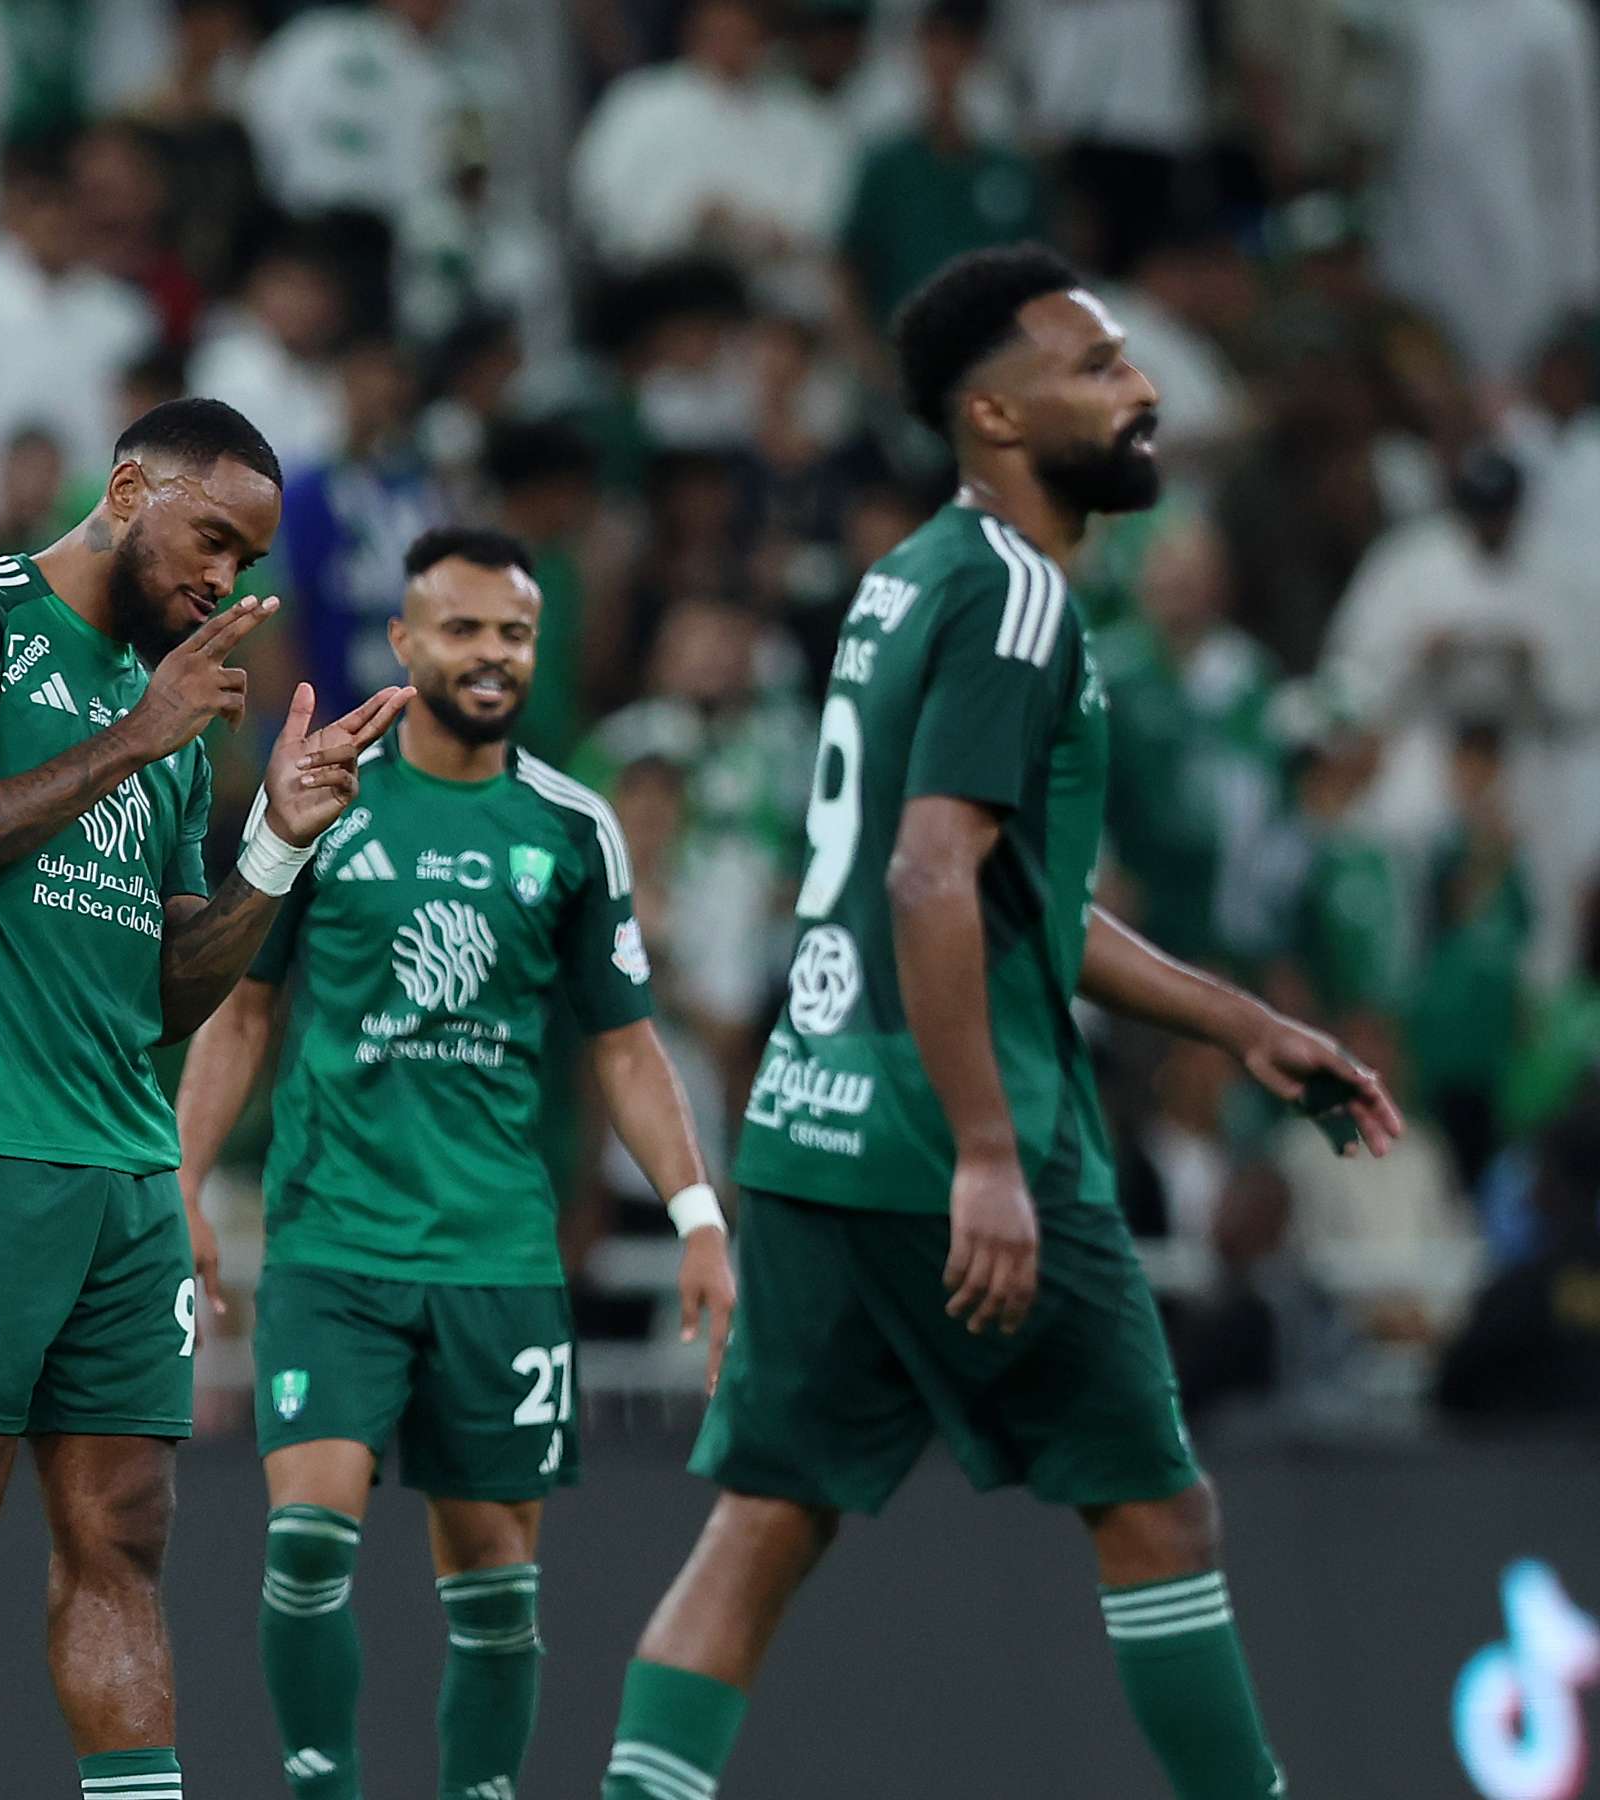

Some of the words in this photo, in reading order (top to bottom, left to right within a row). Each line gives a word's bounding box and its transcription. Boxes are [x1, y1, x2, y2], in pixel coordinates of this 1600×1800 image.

[0, 634, 50, 692] neoleap
[796, 695, 864, 918] 9
[37, 853, 98, 883] الدولية
[33, 883, 75, 911] Red
[77, 893, 113, 921] Sea
[117, 905, 162, 940] Globa
[789, 1121, 864, 1155] cenomi
[174, 1277, 196, 1357] 9
